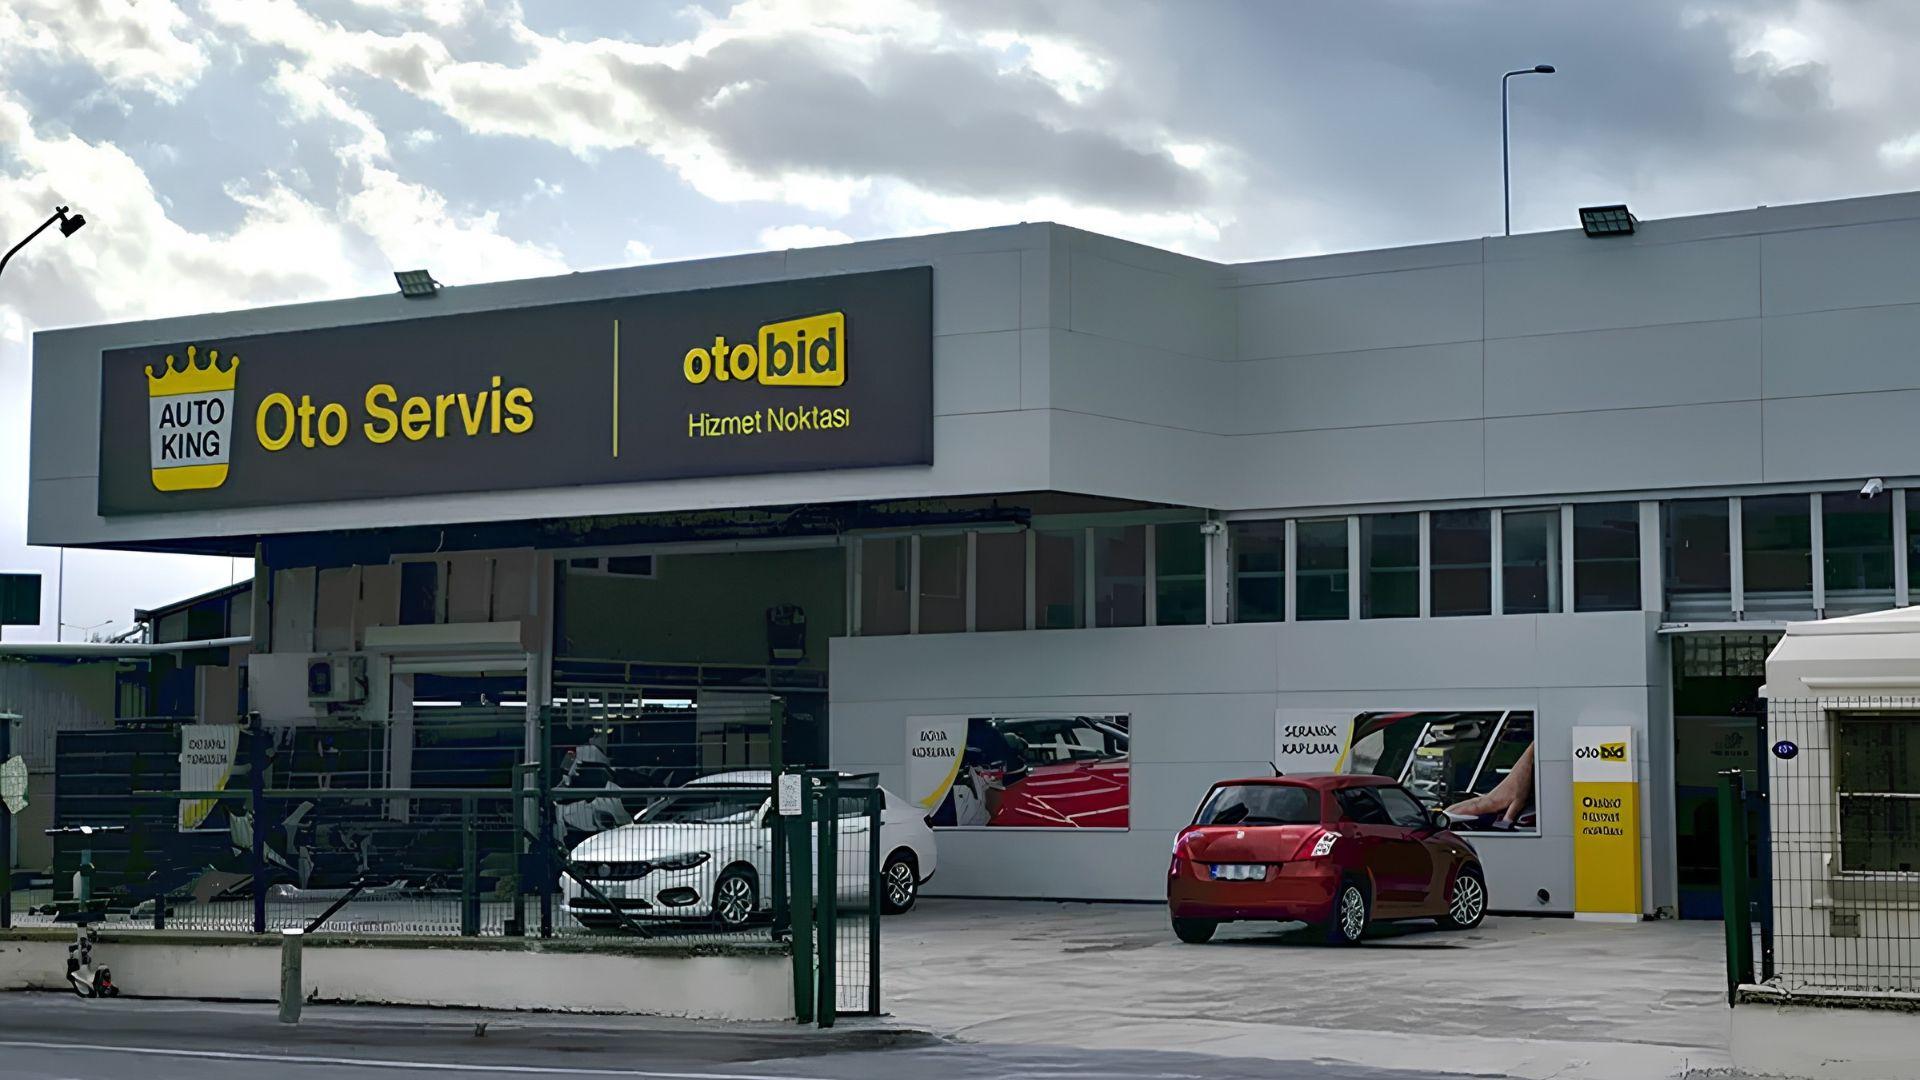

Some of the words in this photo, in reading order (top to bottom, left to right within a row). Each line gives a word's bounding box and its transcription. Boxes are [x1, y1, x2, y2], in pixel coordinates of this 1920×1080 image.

[684, 323, 838, 384] otobid
[159, 398, 225, 429] AUTO
[256, 392, 348, 451] Oto
[363, 375, 534, 443] Servis
[688, 411, 762, 437] Hizmet
[767, 405, 850, 432] Noktası
[161, 430, 220, 460] KING
